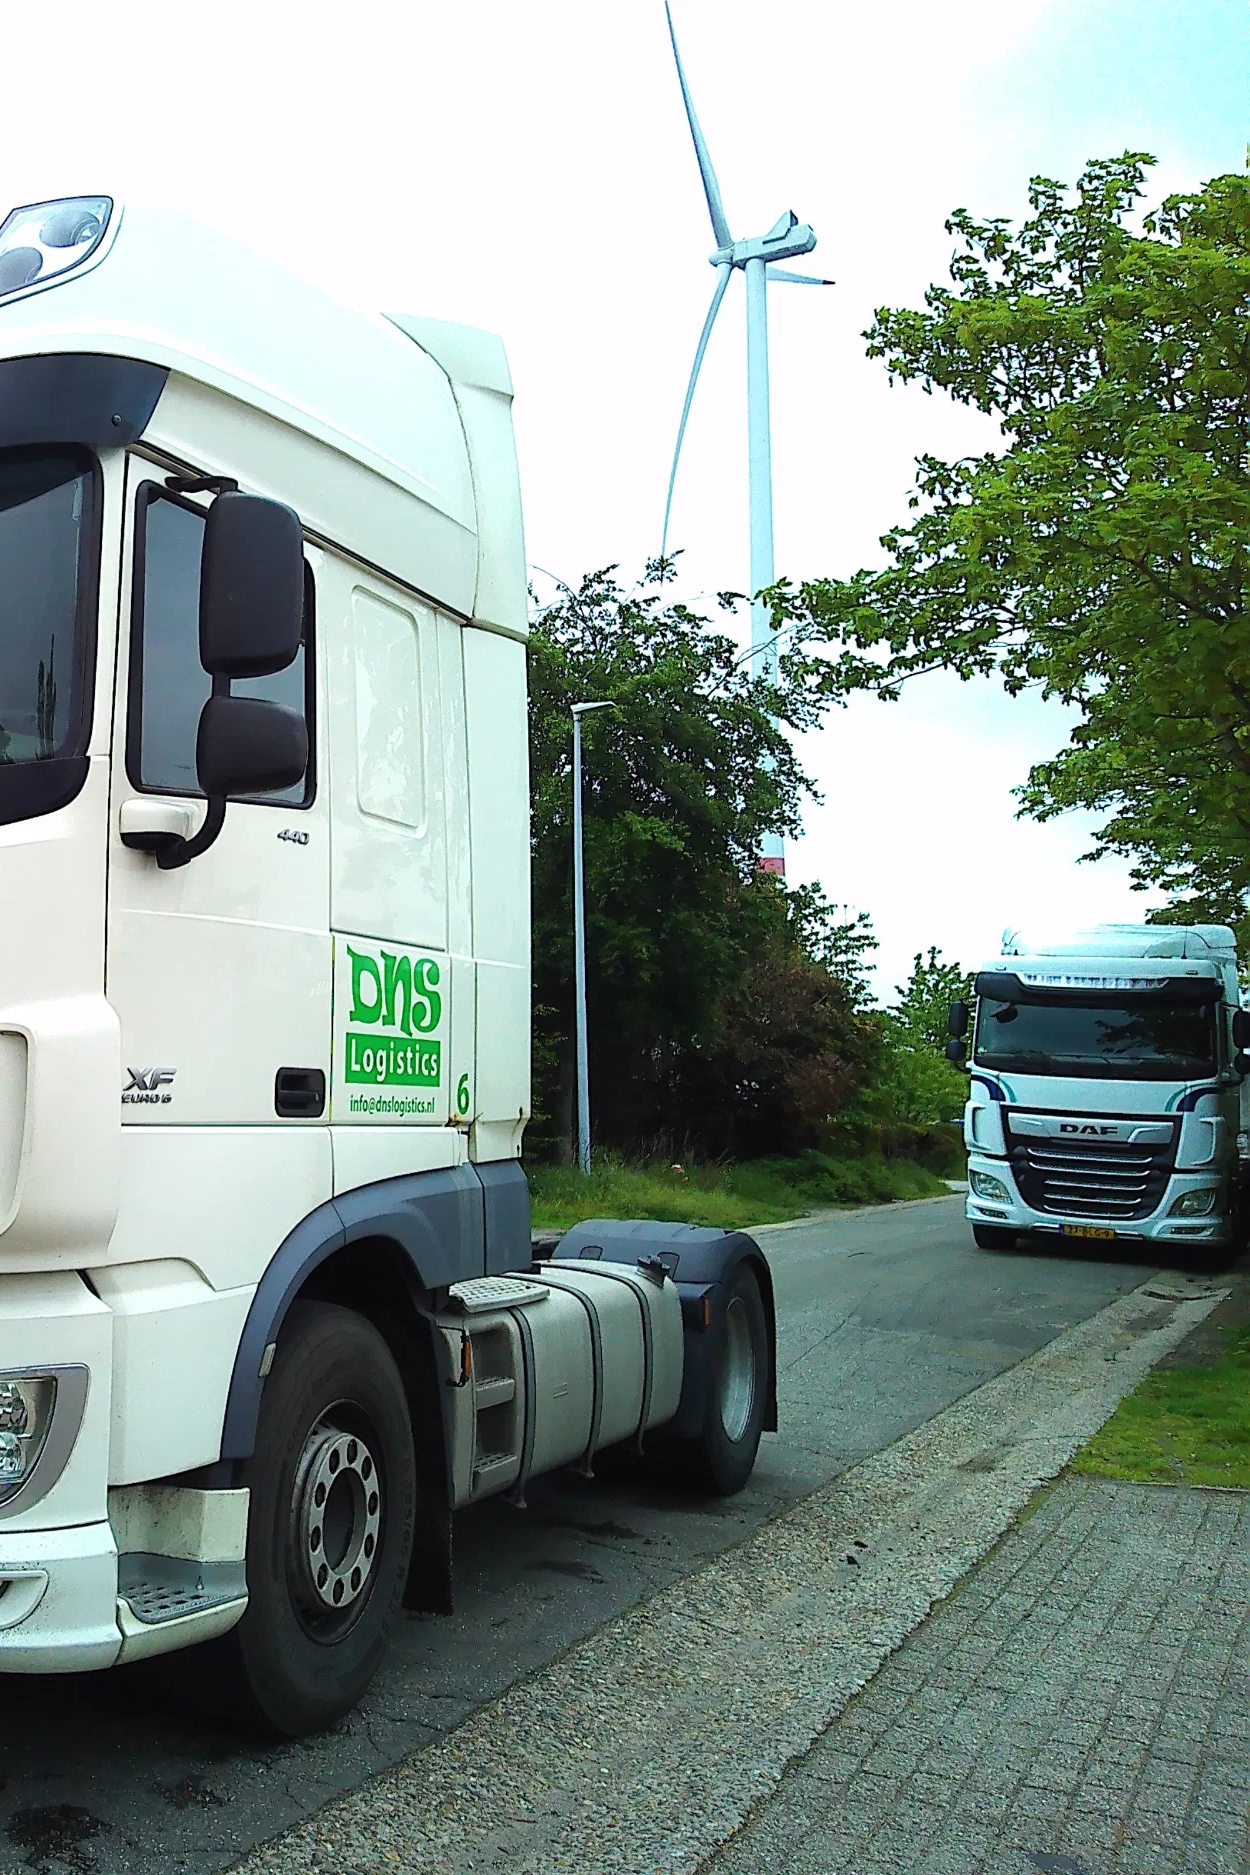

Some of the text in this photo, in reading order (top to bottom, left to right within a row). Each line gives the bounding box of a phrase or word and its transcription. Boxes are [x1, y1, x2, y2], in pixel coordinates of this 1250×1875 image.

[277, 829, 309, 845] 440
[351, 1039, 438, 1082] Logistics
[123, 1067, 177, 1091] XF
[457, 1073, 469, 1115] 6
[350, 1095, 435, 1117] info@dnslogistics.nl
[1060, 1124, 1118, 1135] DAF
